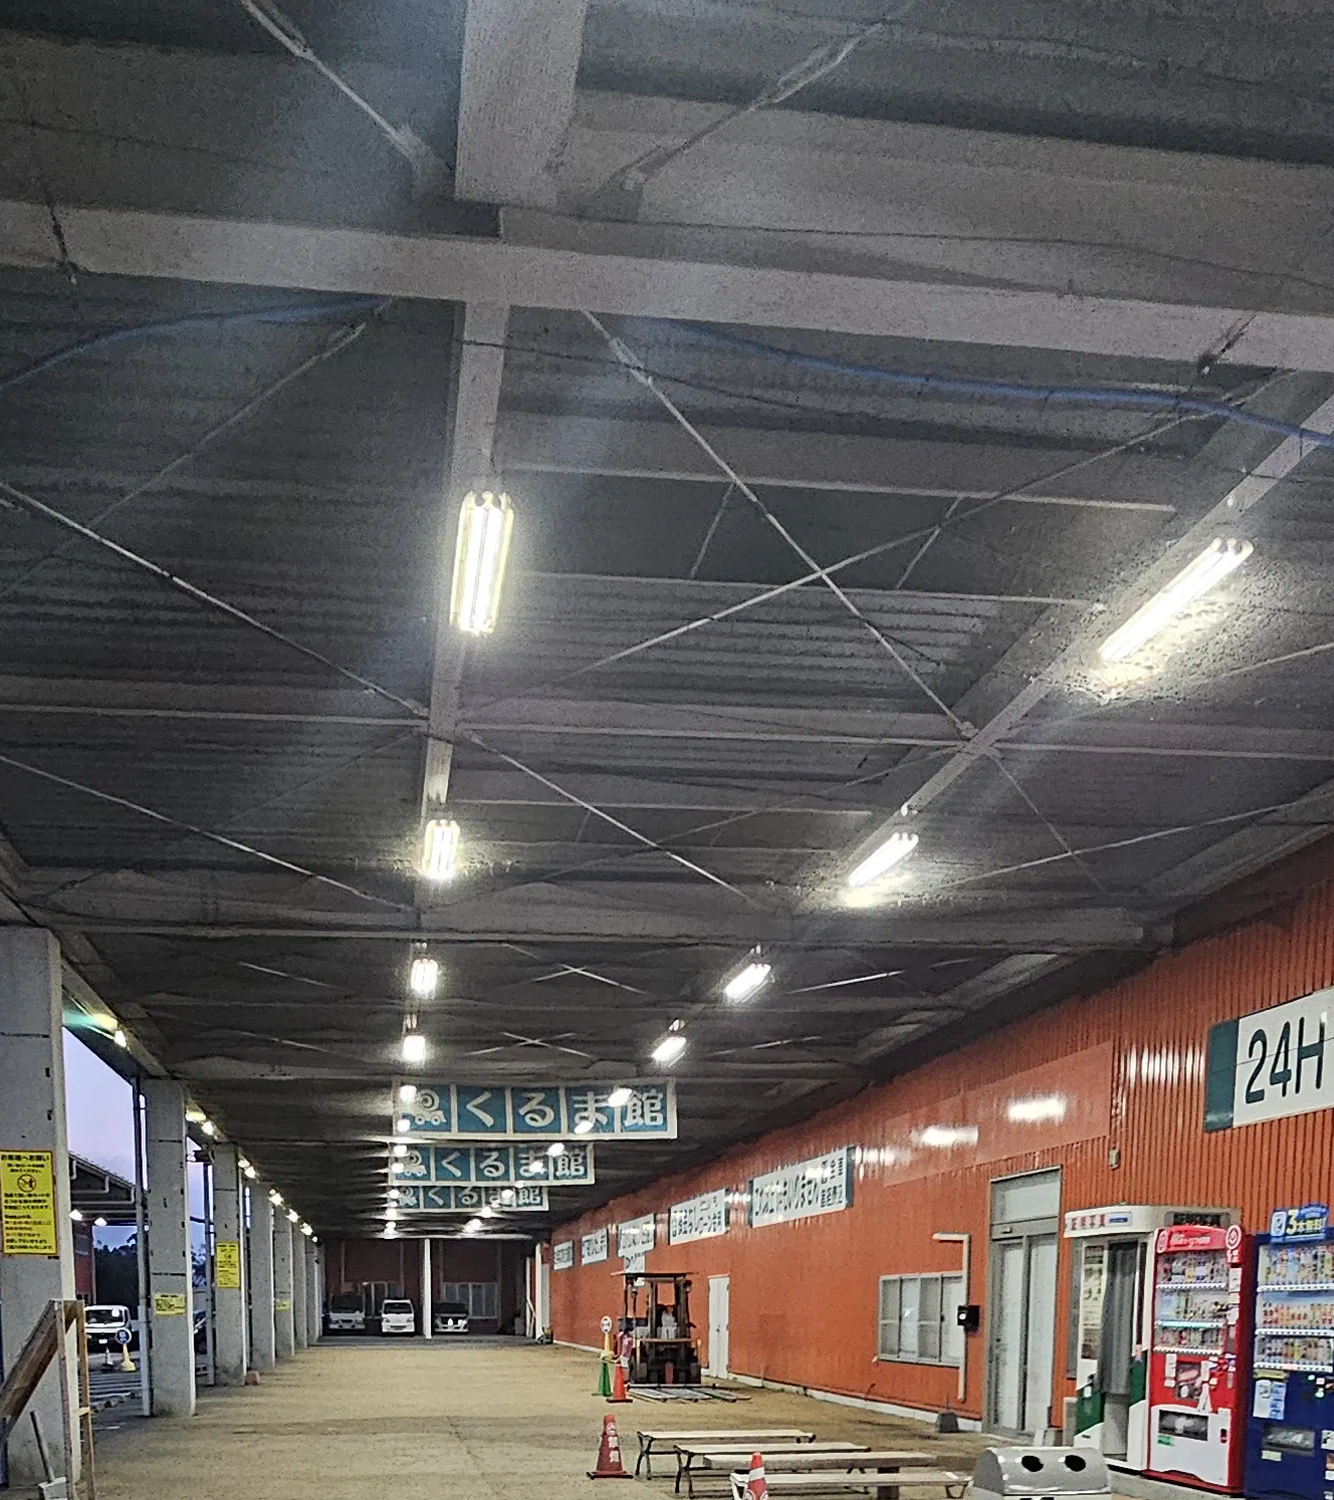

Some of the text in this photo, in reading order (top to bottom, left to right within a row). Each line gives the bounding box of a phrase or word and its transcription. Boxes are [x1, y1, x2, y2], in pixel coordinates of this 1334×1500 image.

[467, 1090, 664, 1127] くるま館
[441, 1151, 584, 1177] くるま館
